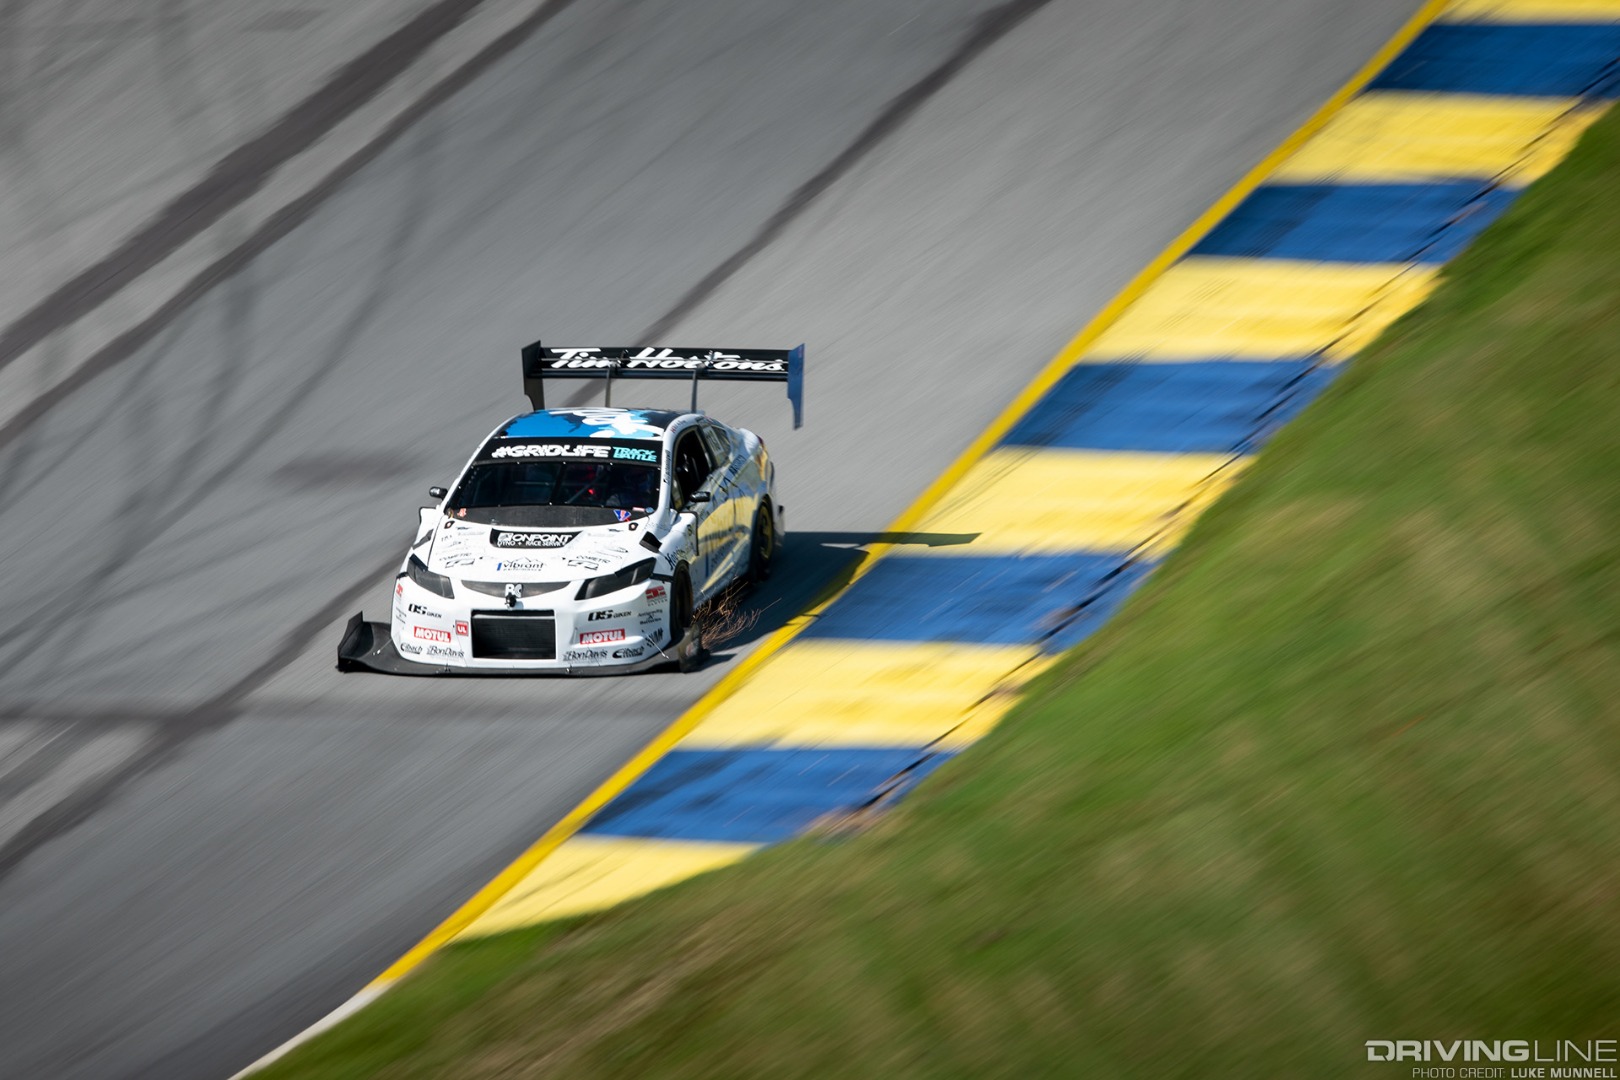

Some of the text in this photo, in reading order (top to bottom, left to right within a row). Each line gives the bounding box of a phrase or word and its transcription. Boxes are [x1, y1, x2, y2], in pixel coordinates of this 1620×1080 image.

[550, 346, 785, 371] Tim Hortons
[491, 444, 612, 458] #GRIDLIFE
[415, 628, 450, 642] MOTUL
[581, 630, 624, 644] MOTUL
